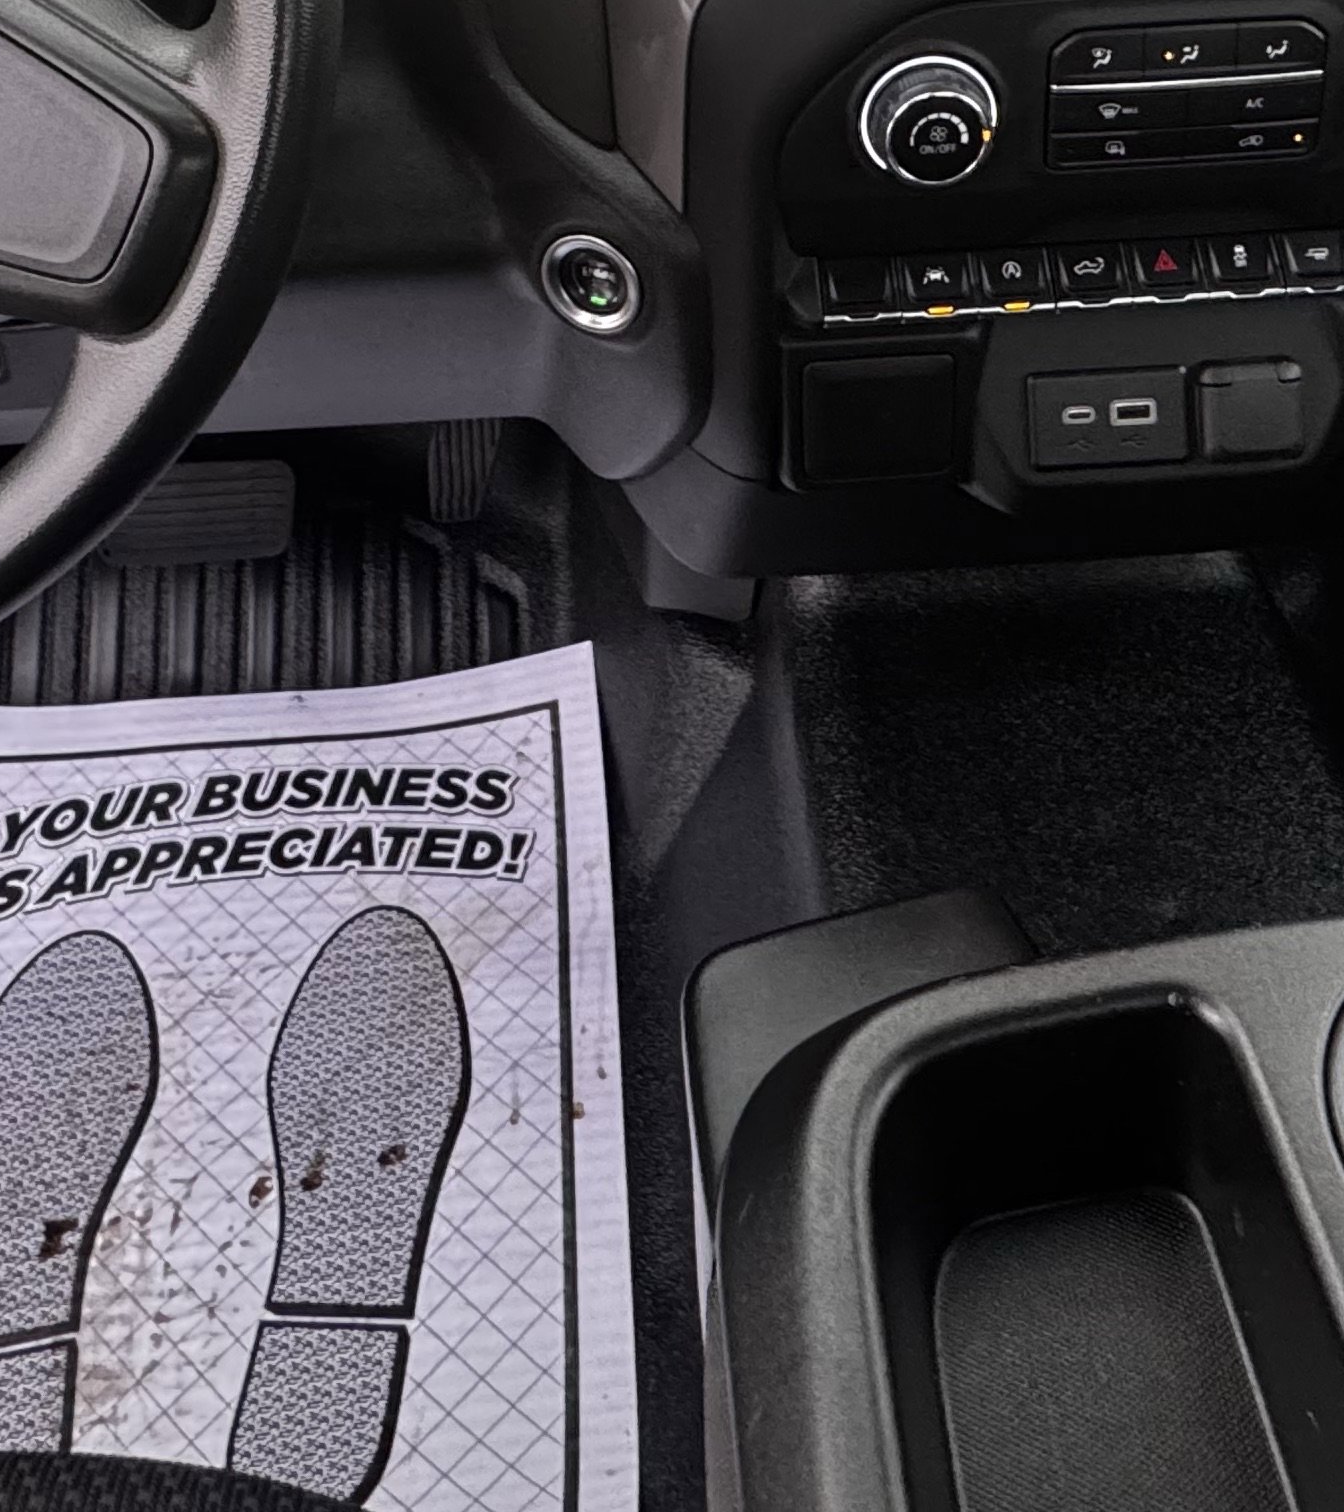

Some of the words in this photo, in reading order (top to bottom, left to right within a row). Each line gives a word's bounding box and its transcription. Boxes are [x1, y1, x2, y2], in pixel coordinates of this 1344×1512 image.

[1245, 96, 1265, 109] A/C
[192, 766, 518, 816] BUSINESS
[35, 826, 535, 908] APPRECIATED!
